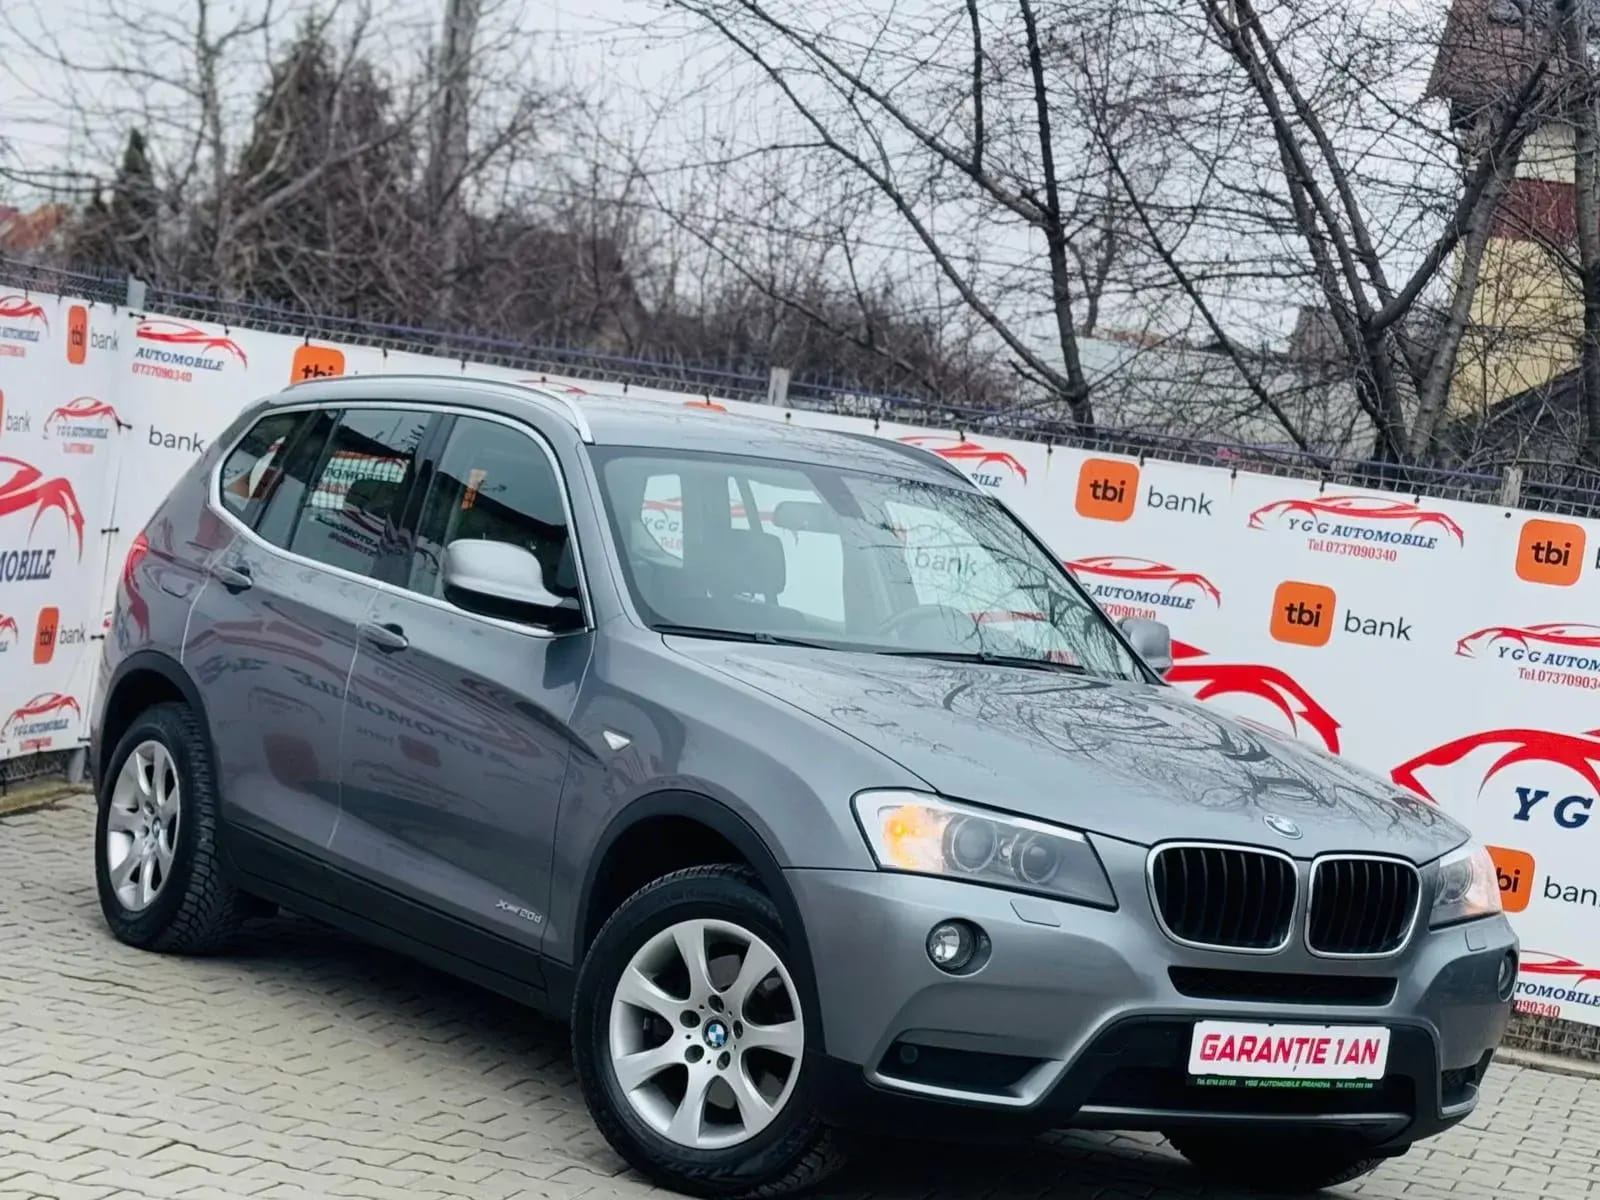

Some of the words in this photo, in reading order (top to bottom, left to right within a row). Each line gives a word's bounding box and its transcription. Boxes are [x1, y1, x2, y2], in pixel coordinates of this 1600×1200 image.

[91, 327, 119, 351] bank
[135, 346, 225, 371] AUTOMOBILE
[5, 408, 31, 432] bank
[148, 424, 205, 453] bank
[1089, 478, 1126, 503] tbi
[1147, 485, 1214, 516] bank
[1331, 525, 1438, 550] AUTOMOBILE
[914, 547, 977, 576] bank
[1531, 540, 1572, 566] tbi
[1092, 584, 1196, 609] AUTOMOBILE
[59, 621, 86, 645] bank
[1285, 602, 1322, 627] tbi
[1344, 609, 1412, 641] bank
[1200, 1034, 1332, 1073] GARANȚIE
[1334, 1038, 1345, 1065] 1
[1343, 1038, 1381, 1065] AN
